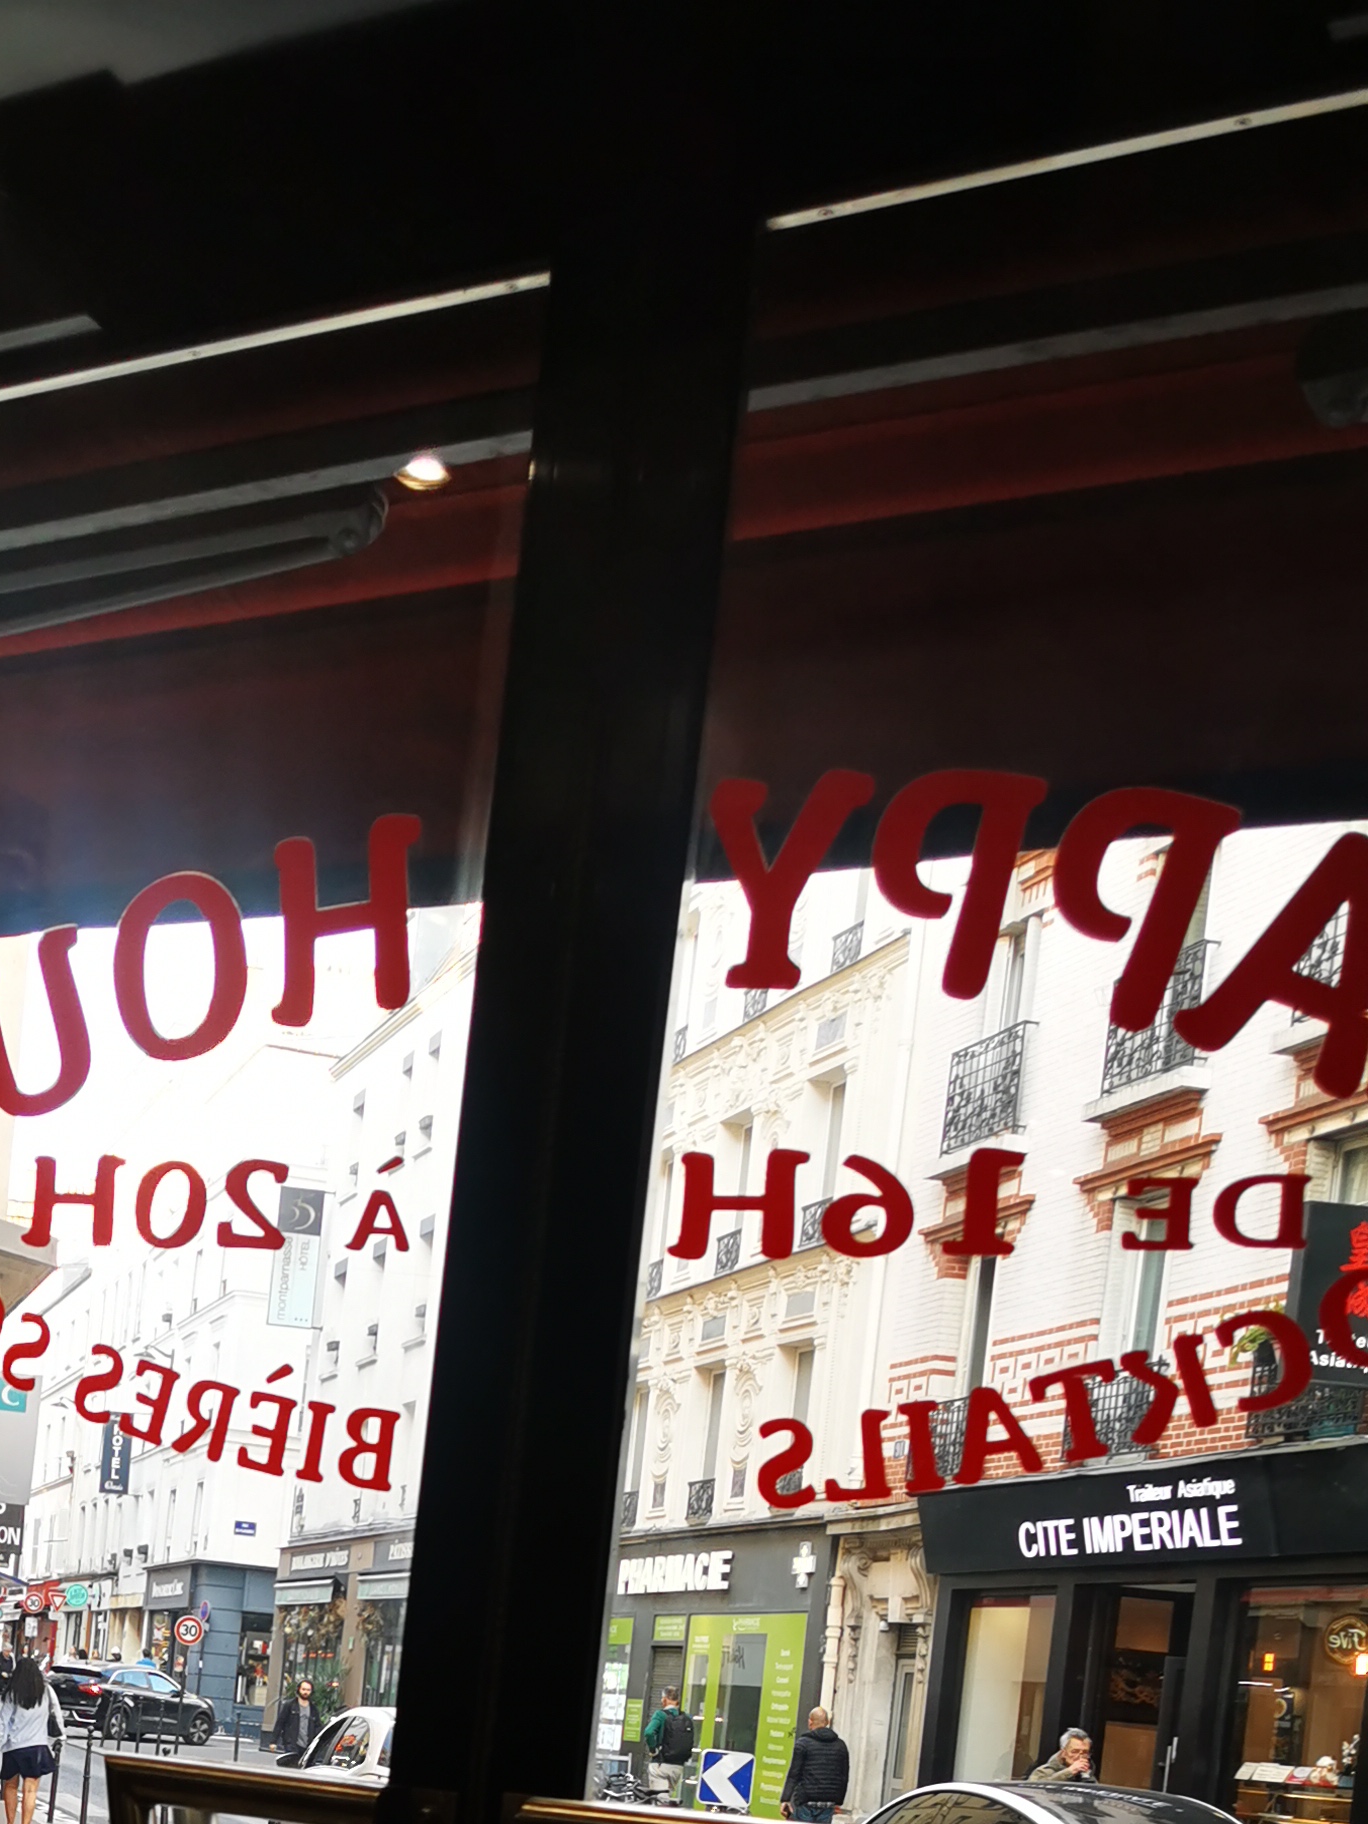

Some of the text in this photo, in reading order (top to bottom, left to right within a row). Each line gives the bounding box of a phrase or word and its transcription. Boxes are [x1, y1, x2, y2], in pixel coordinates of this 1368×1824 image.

[1018, 1505, 1242, 1558] CITE IMPERIALE
[181, 1624, 197, 1637] 30
